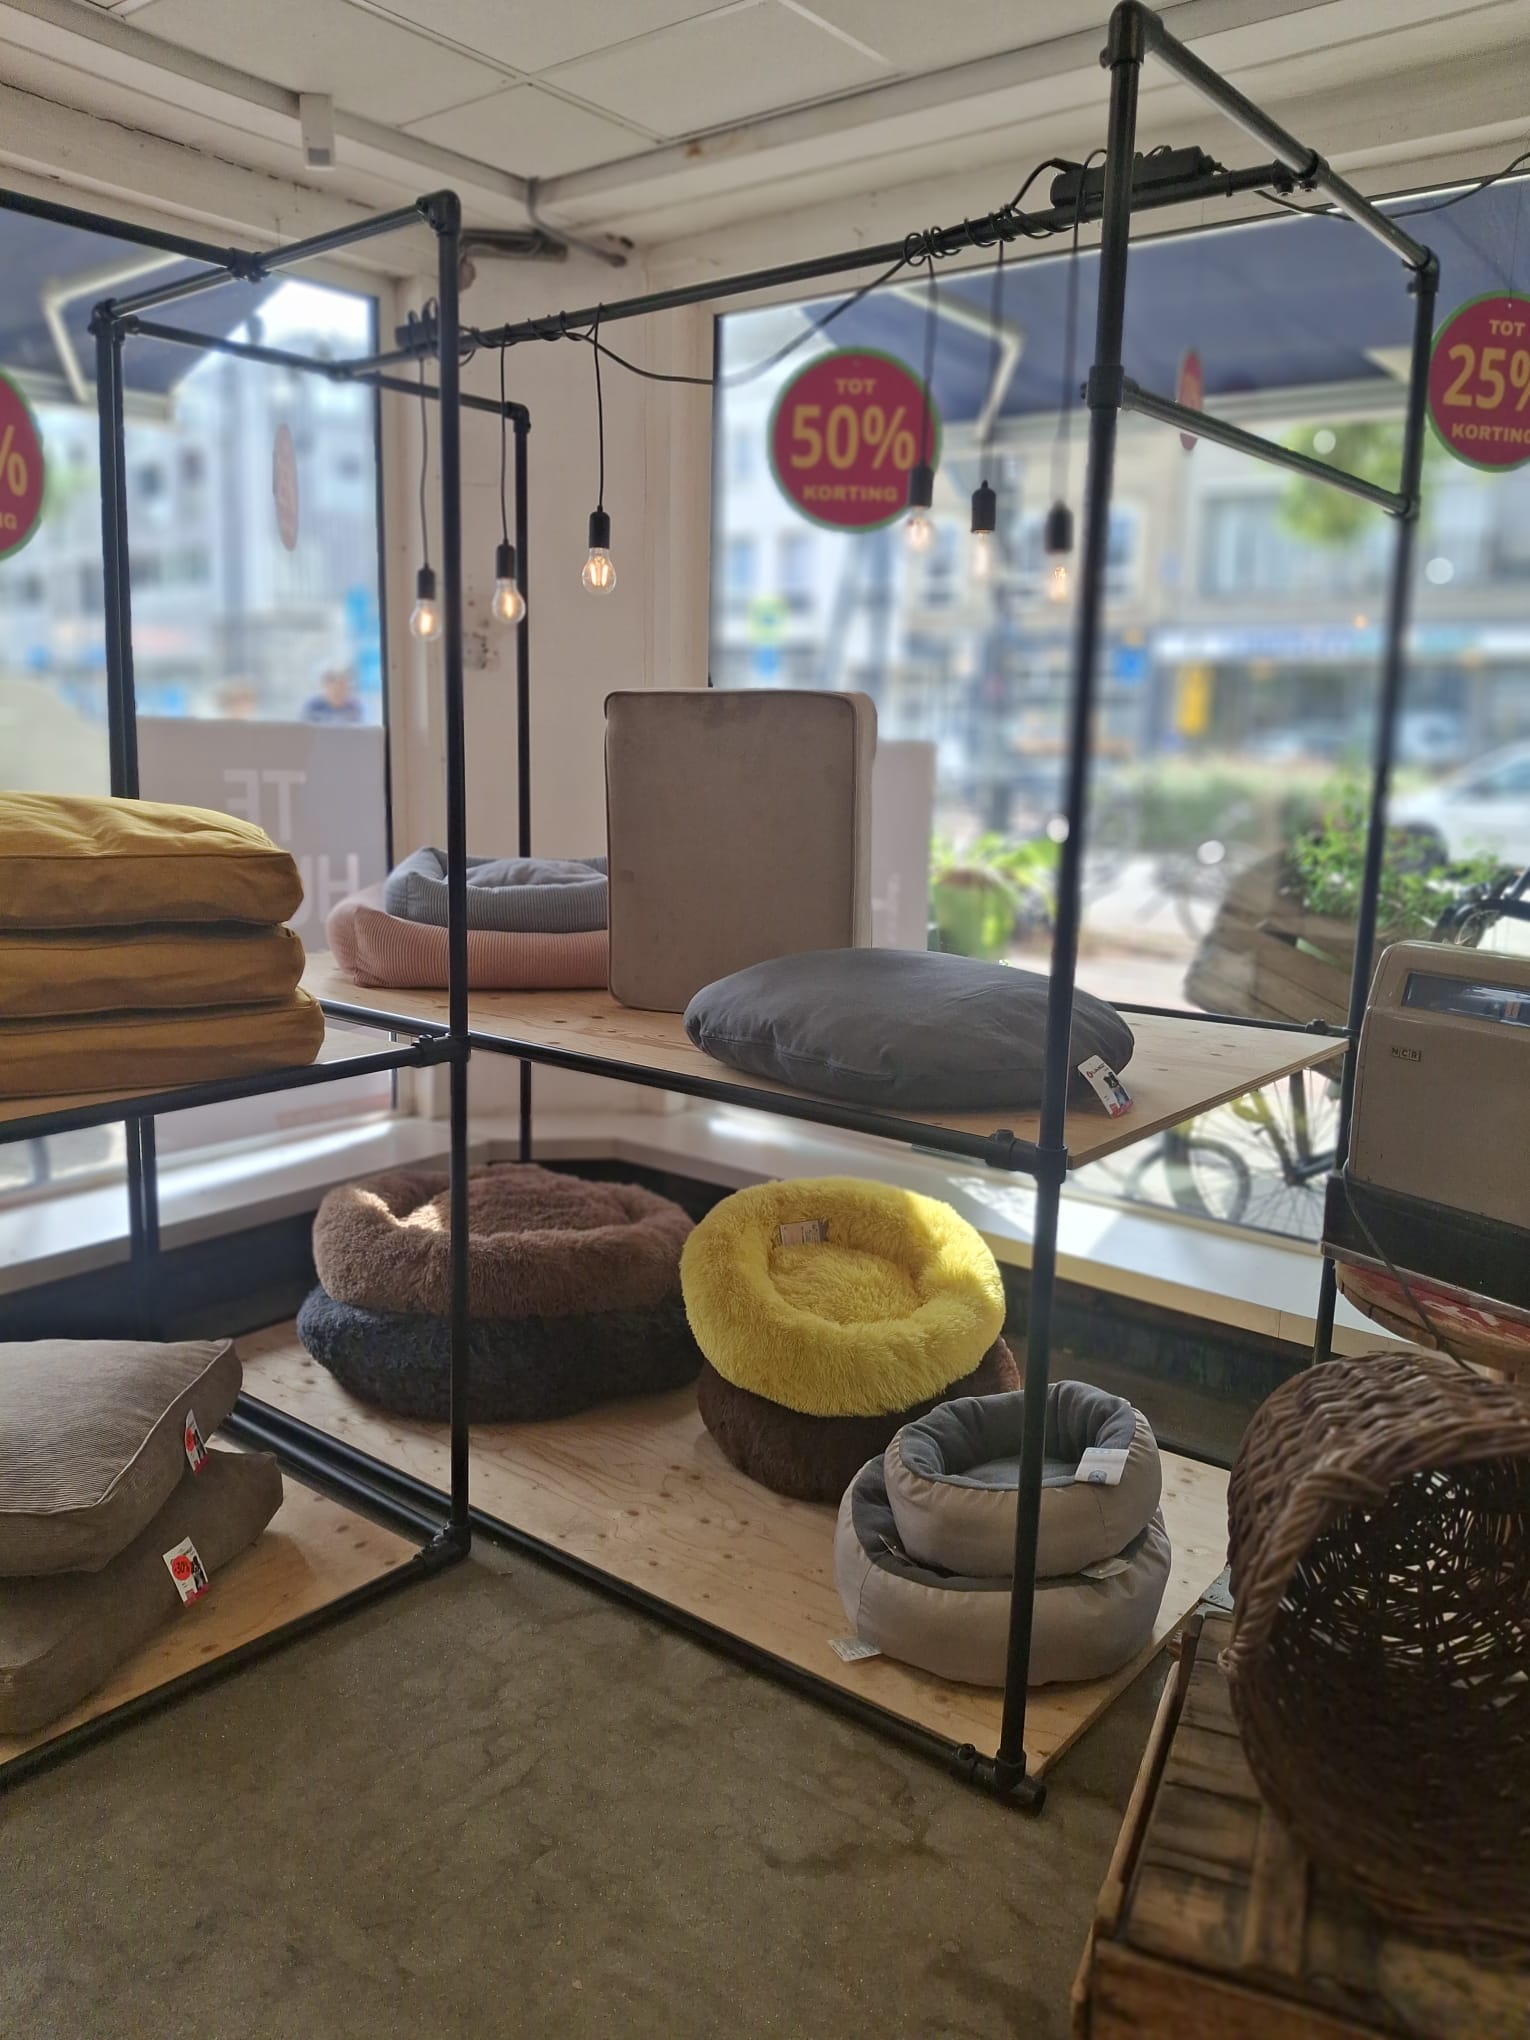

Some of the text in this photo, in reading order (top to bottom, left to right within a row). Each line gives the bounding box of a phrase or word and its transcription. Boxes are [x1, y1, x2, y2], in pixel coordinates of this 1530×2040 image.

[1489, 320, 1526, 336] TOT
[835, 378, 876, 395] TOT
[790, 404, 916, 471] 50%
[802, 484, 898, 503] KORTING
[1391, 1047, 1420, 1061] NCR
